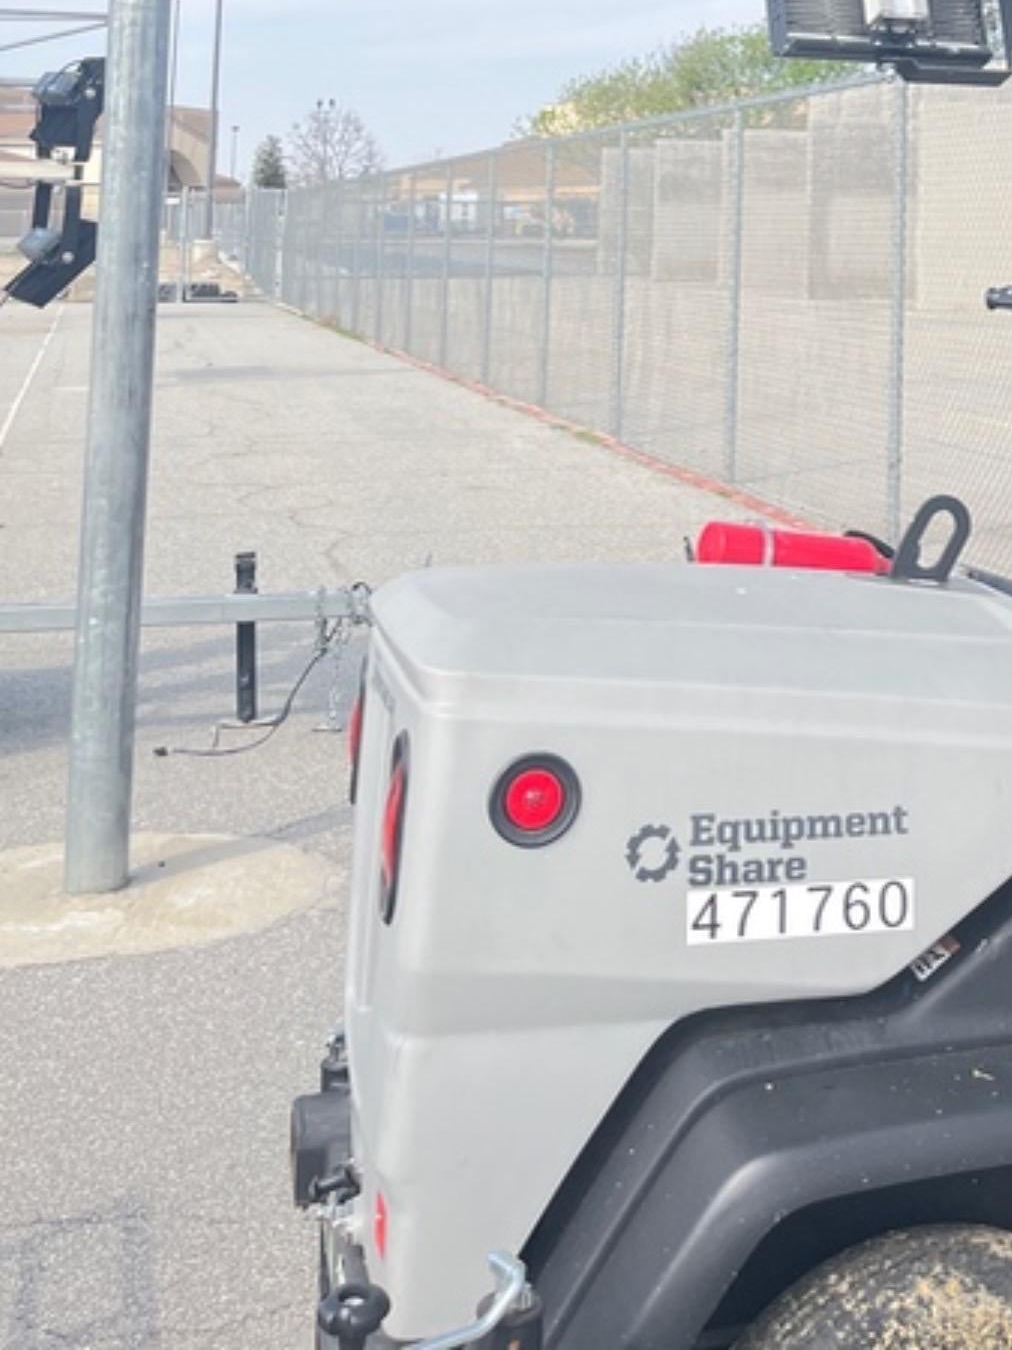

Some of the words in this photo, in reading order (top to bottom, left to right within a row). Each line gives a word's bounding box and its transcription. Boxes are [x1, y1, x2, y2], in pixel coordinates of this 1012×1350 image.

[689, 806, 909, 852] Equipment
[688, 854, 808, 887] Share
[690, 880, 909, 940] 471760
